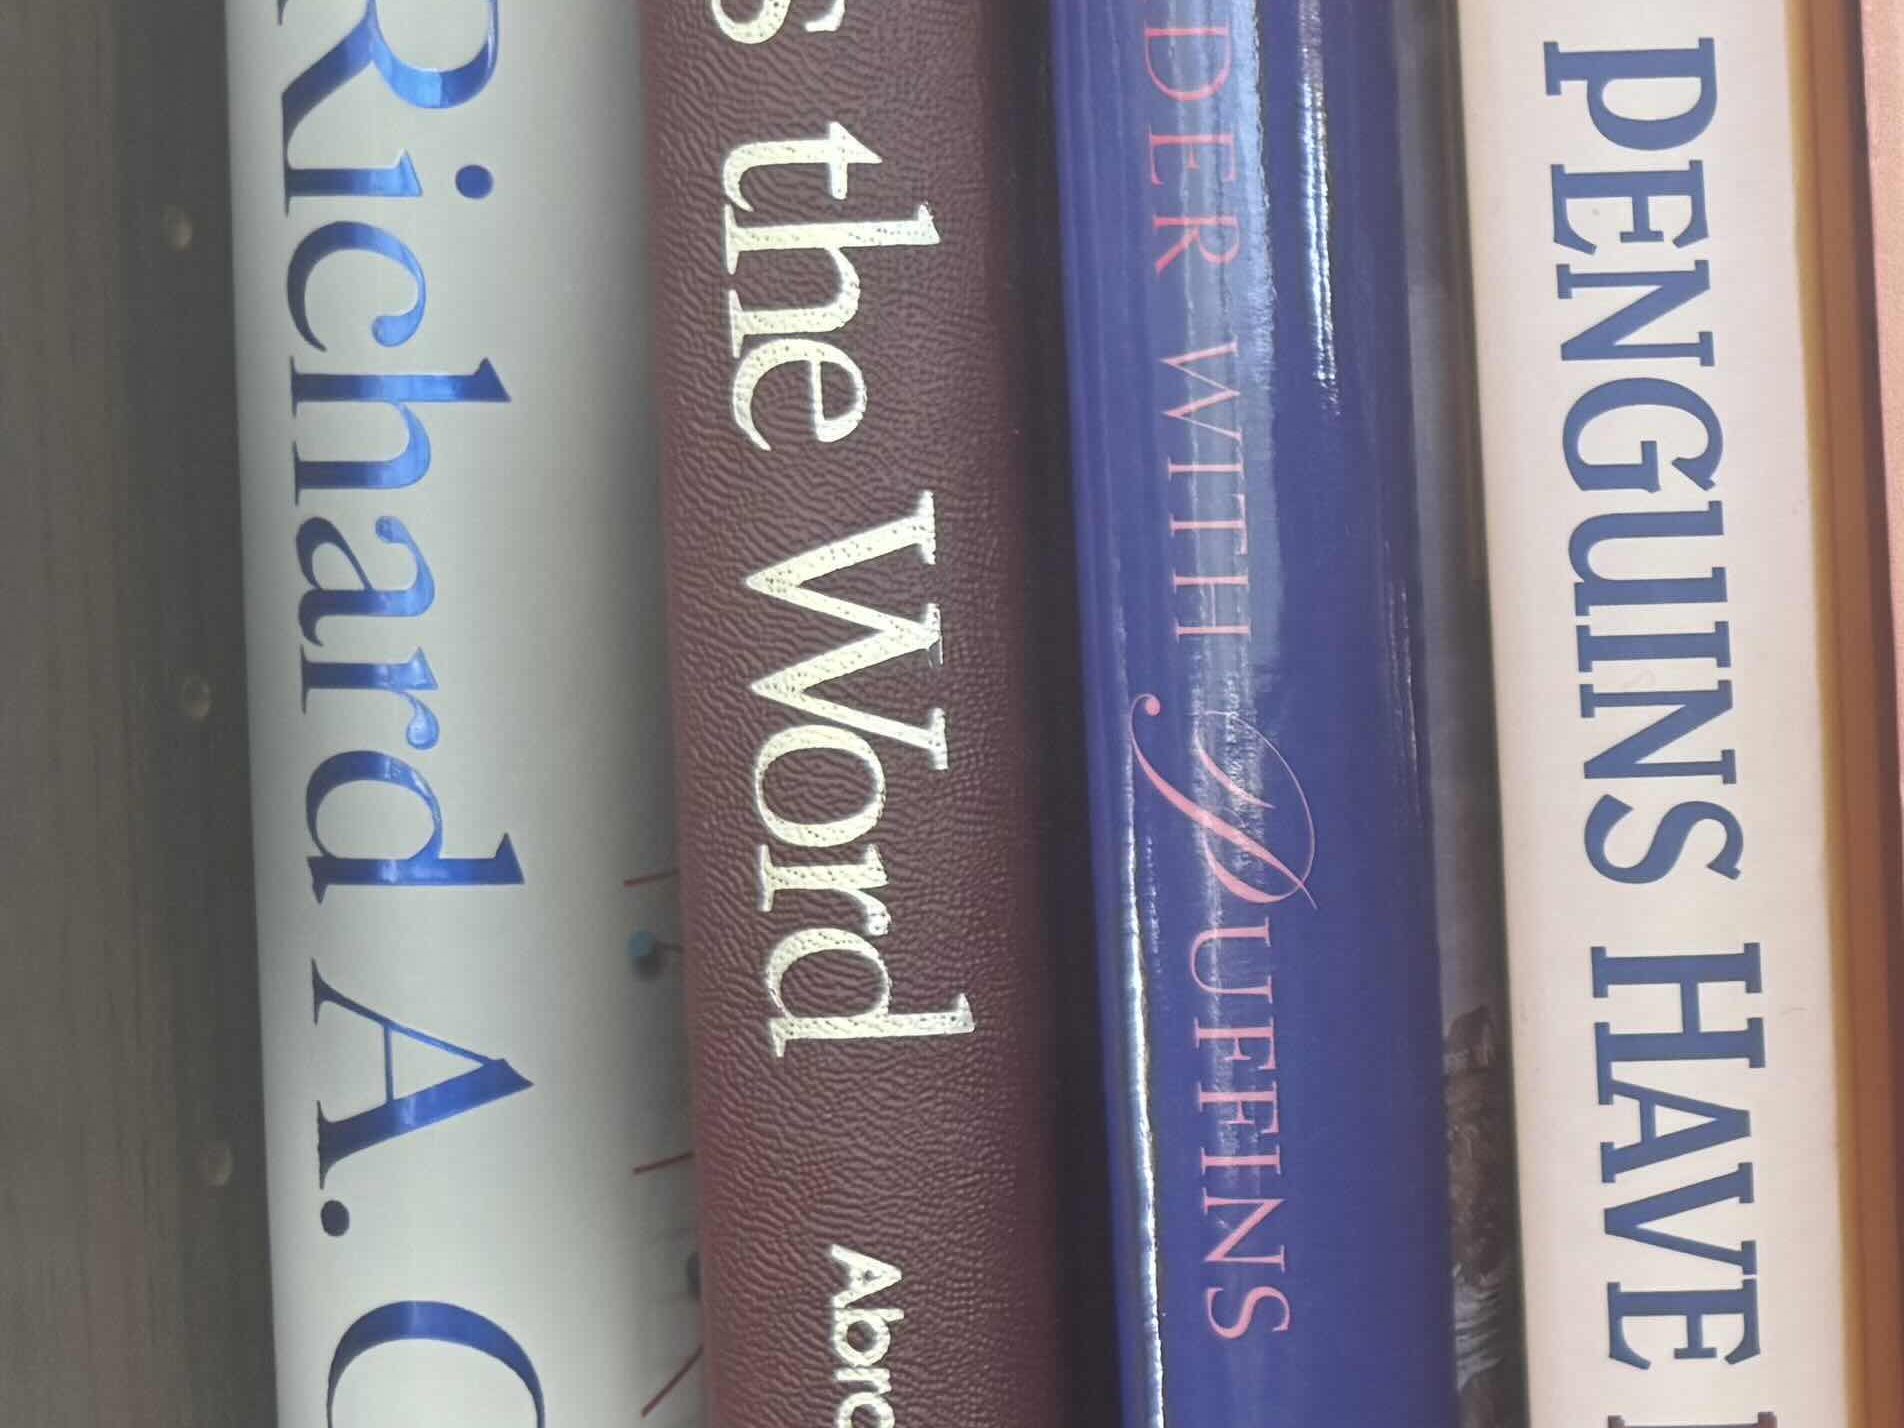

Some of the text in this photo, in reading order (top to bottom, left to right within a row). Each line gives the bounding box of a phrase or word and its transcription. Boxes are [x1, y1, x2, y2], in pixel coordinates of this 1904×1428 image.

[720, 120, 940, 452] the
[1155, 340, 1255, 642] WITH
[1543, 37, 1744, 884] PENGUINS
[744, 490, 976, 1059] Word
[306, 962, 536, 1240] A.
[1128, 692, 1315, 1342] PUFFINS
[1592, 942, 1765, 1370] HAVE
